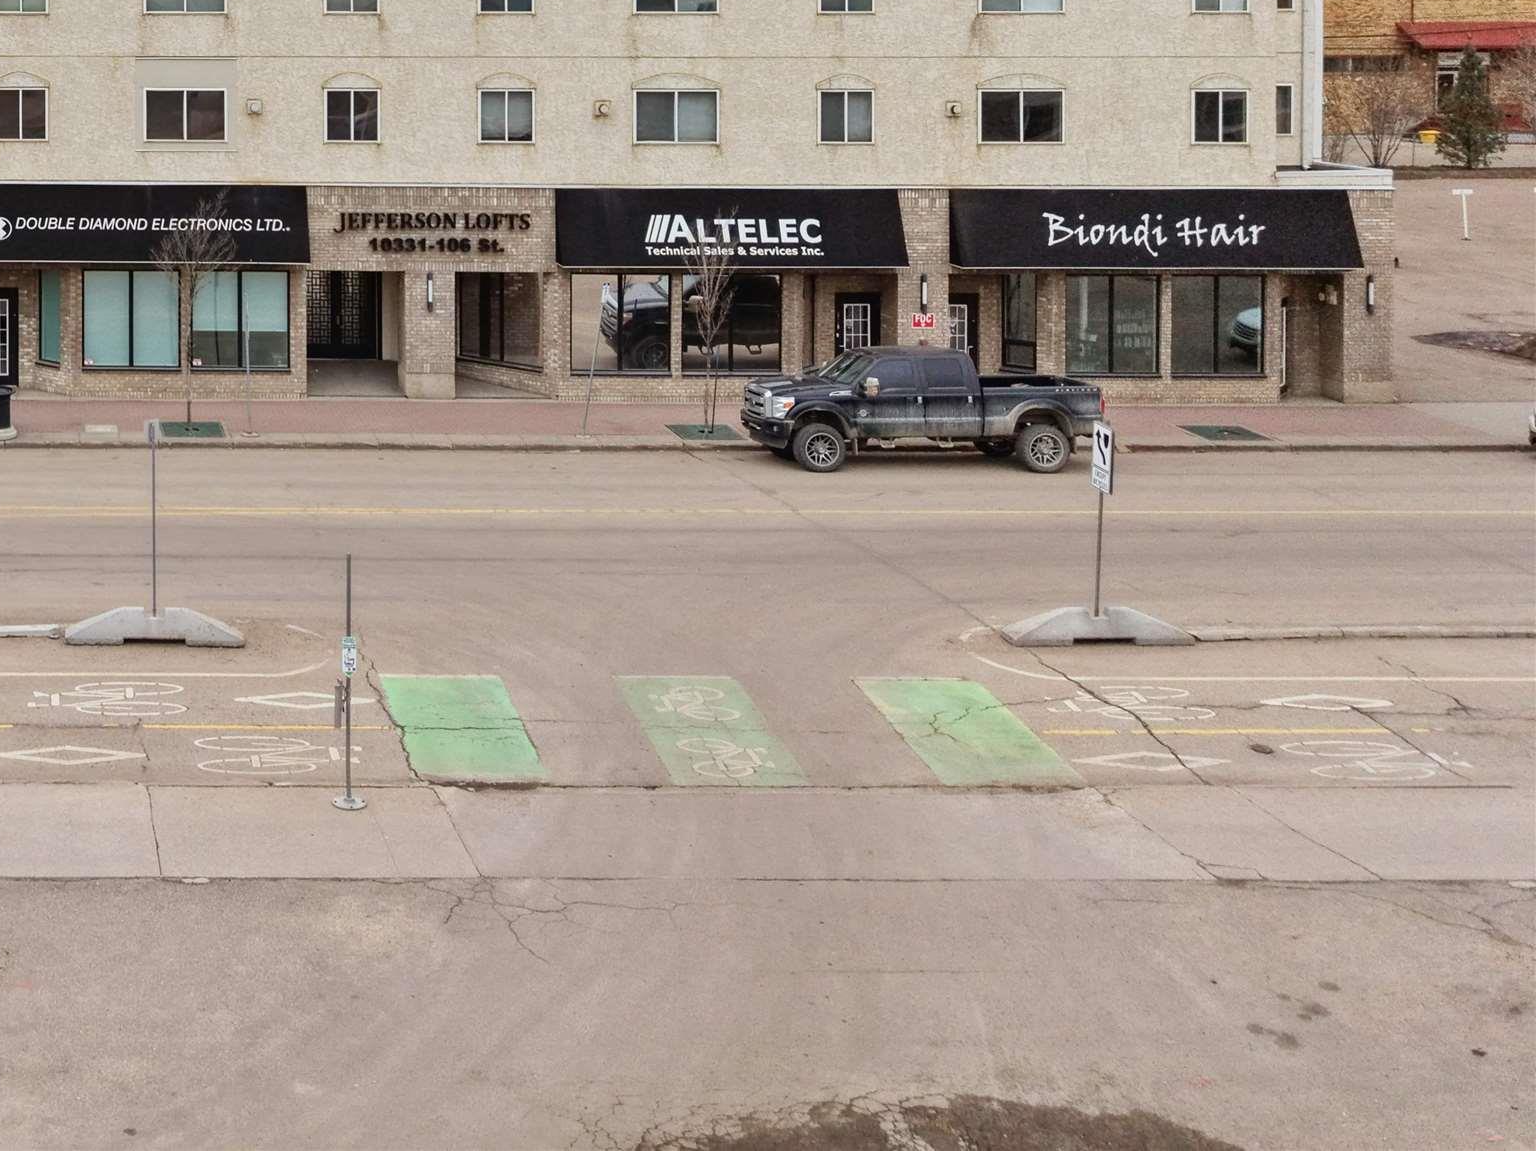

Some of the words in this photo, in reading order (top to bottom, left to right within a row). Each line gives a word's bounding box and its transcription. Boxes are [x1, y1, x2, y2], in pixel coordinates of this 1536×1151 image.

[15, 217, 75, 231] DOUBLE
[78, 217, 148, 231] DIAMOND
[151, 217, 253, 232] ELECTRONICS
[333, 212, 457, 233] JEFFERSON
[464, 212, 531, 231] LOFTS
[1042, 212, 1168, 257] Biondi
[1175, 213, 1266, 248] Hair
[368, 238, 471, 253] 10331-106
[477, 238, 505, 253] St.
[645, 245, 701, 256] Technical
[703, 246, 735, 256] Sales
[737, 246, 747, 256] &
[749, 246, 799, 256] Services
[801, 246, 825, 256] Inc.
